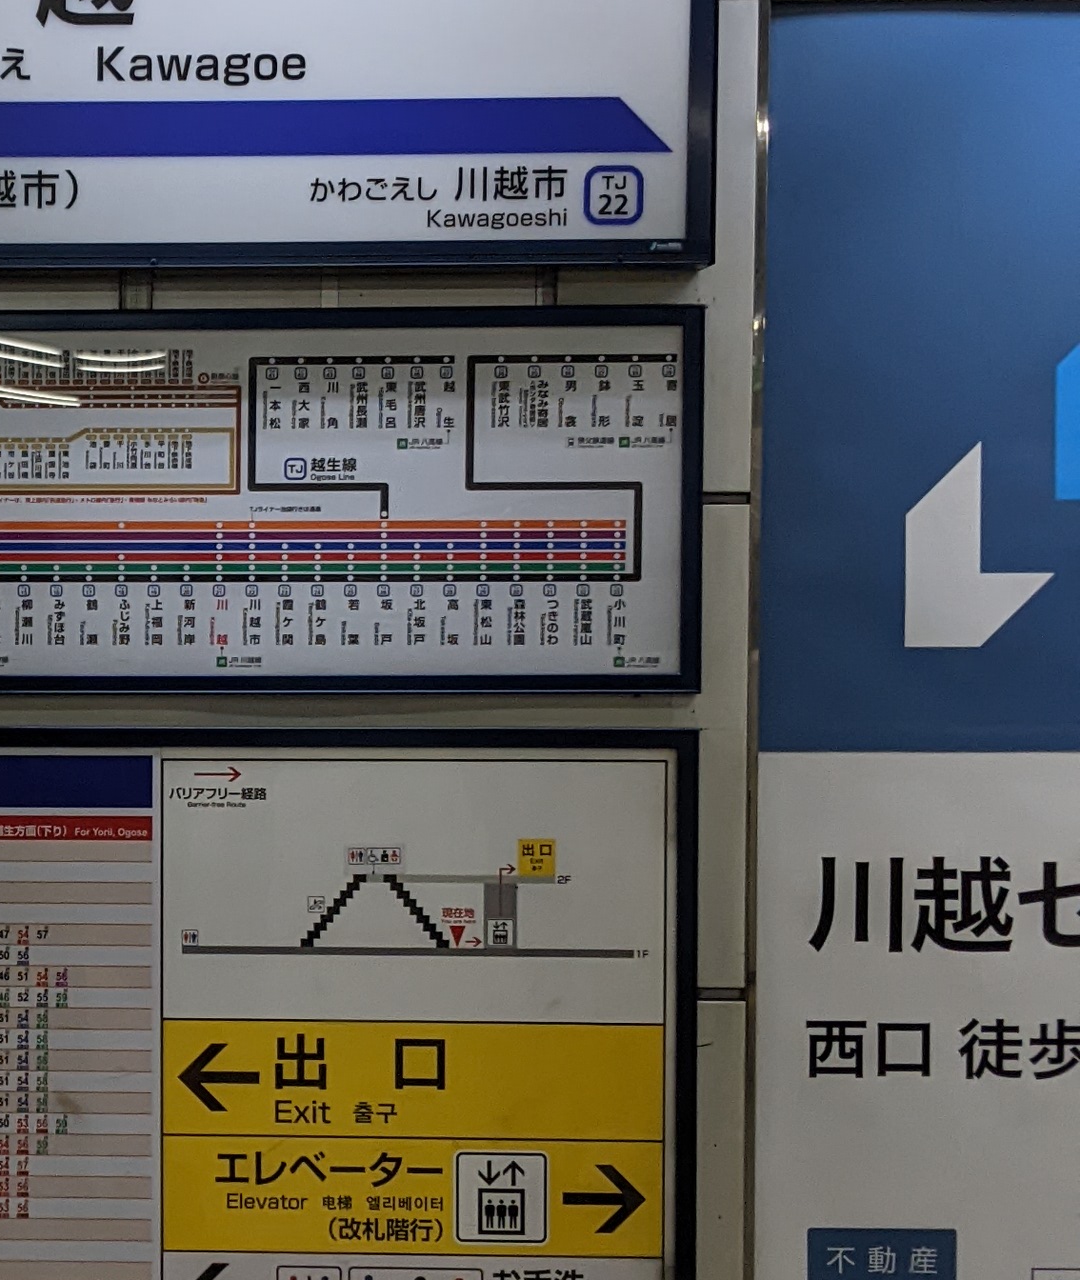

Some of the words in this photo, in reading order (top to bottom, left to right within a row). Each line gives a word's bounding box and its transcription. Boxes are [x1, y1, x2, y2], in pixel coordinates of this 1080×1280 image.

[96, 45, 307, 87] Kawagoe
[309, 176, 438, 203] かわごえし
[454, 166, 567, 202] 川越市
[601, 175, 628, 190] TJ
[426, 208, 568, 229] Kawagoeshi
[598, 192, 628, 215] 22
[269, 384, 281, 429] 一本松
[327, 382, 339, 429] 川角
[288, 464, 303, 474] TJ
[310, 458, 357, 473] 越生線
[54, 599, 66, 646] みずほ台
[119, 599, 131, 646] ふじみ野
[216, 599, 229, 646] 川越
[249, 599, 262, 646] 川越市
[447, 599, 460, 646] 高坂
[480, 599, 493, 646] 東松山
[546, 599, 560, 646] つきのわ
[169, 788, 267, 800] バリアフリー経路
[74, 826, 90, 836] For
[118, 826, 148, 838] Ogose
[522, 844, 552, 856] 出口
[557, 876, 571, 884] 2F
[808, 856, 1080, 953] 川越七
[637, 950, 649, 958] 1F
[806, 1019, 931, 1079] 西口
[958, 1018, 1080, 1080] 徒歩
[274, 1100, 331, 1124] Exit
[352, 1103, 397, 1123] 출구
[215, 1152, 444, 1187] エレベーター
[226, 1193, 308, 1210] Elevator
[366, 1195, 444, 1212] 엘리베이터
[826, 1245, 938, 1275] 不動産
